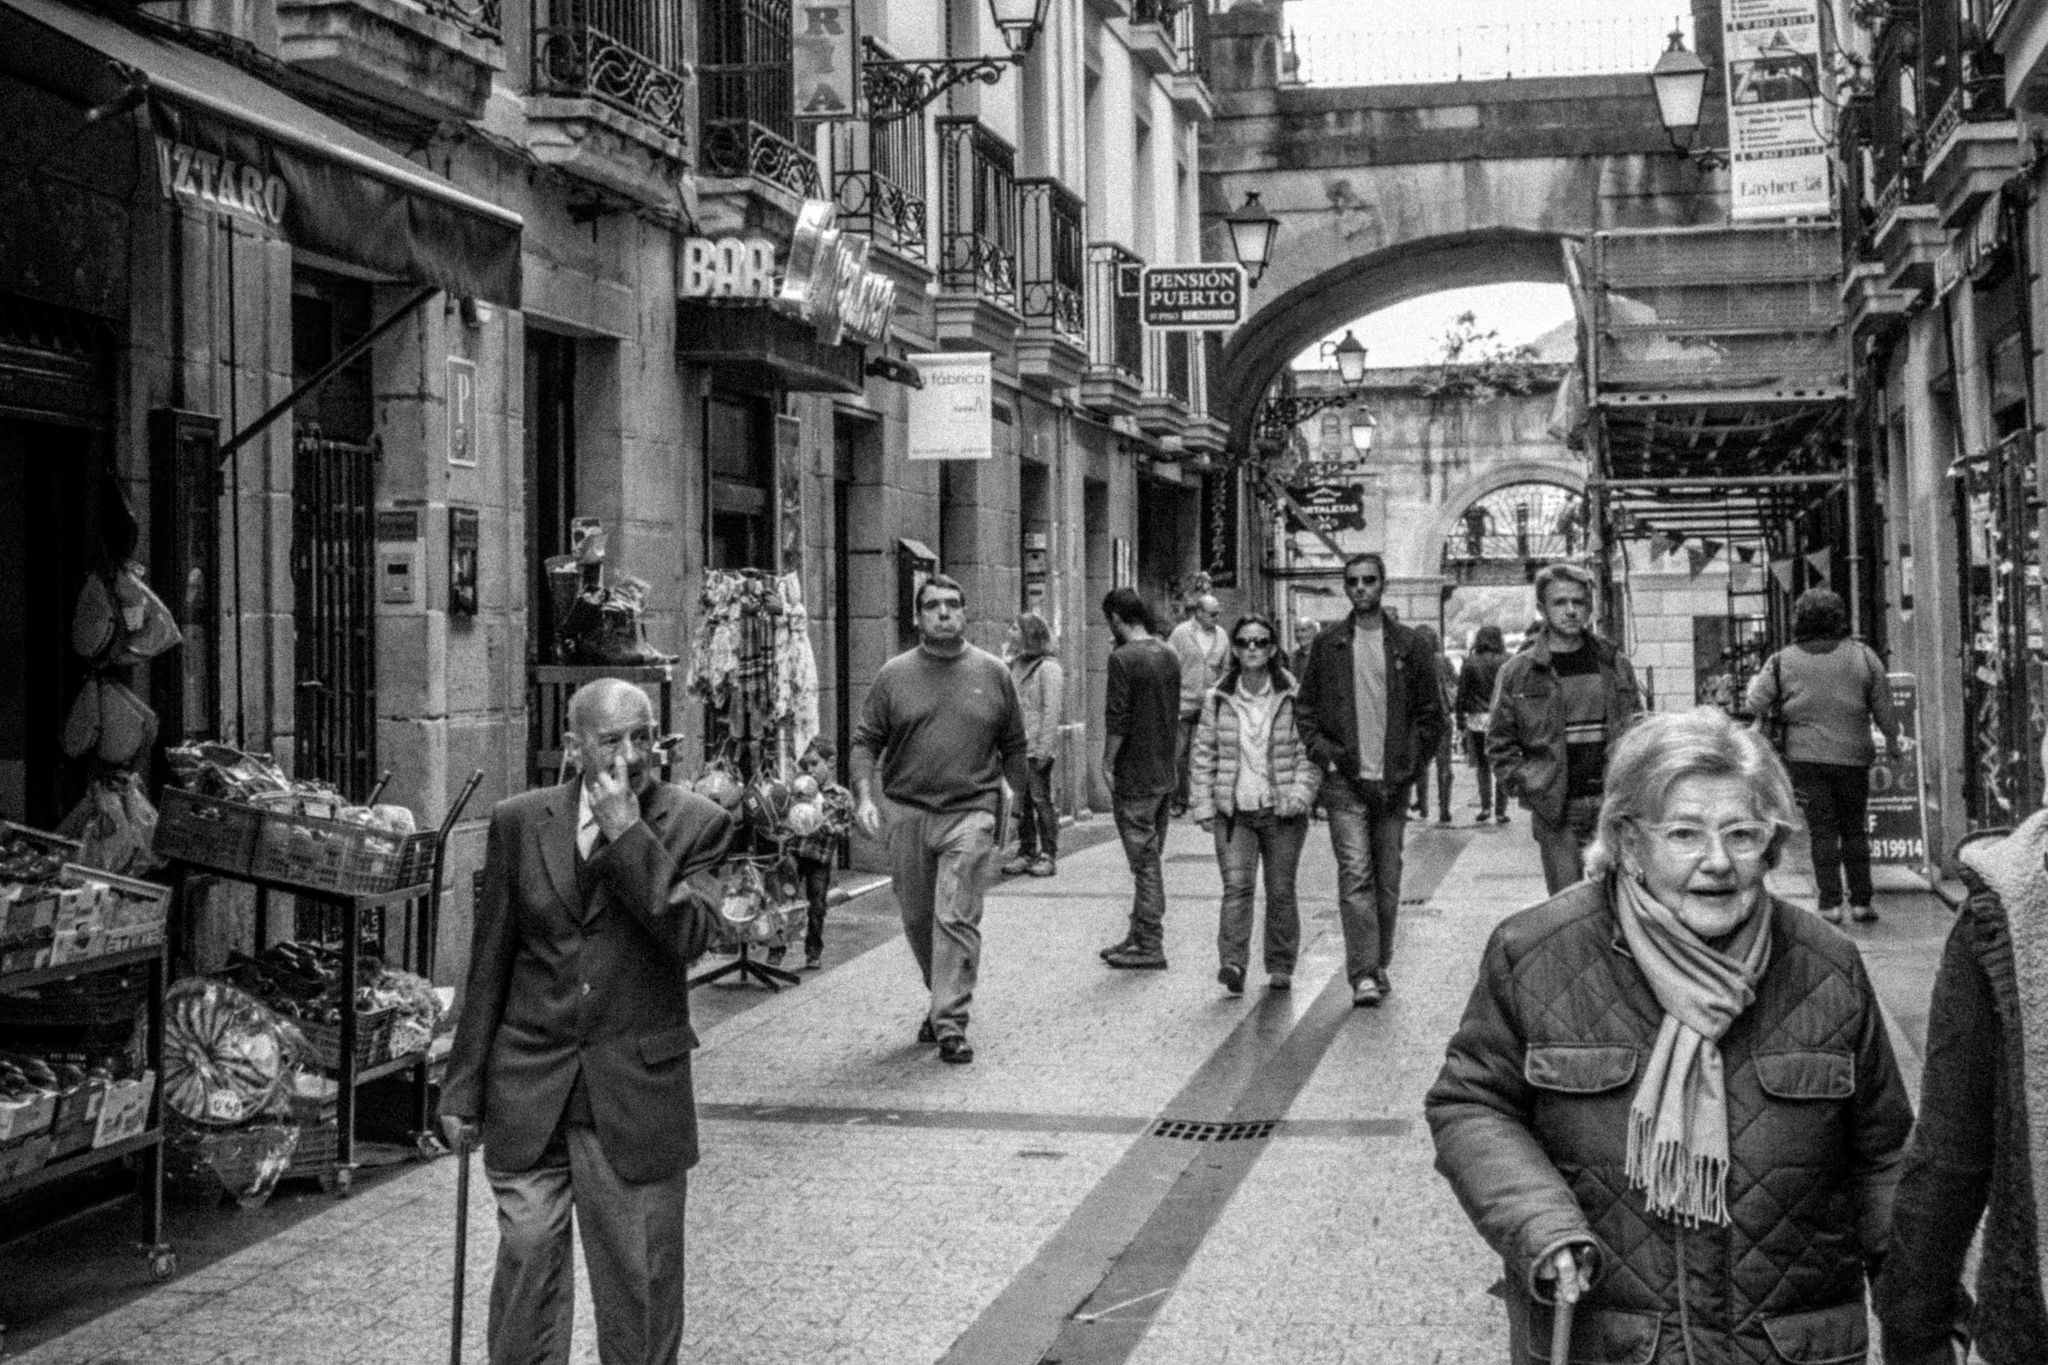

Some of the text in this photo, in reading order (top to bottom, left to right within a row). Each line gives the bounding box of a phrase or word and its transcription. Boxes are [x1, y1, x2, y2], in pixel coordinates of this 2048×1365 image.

[682, 236, 776, 298] BAR
[1150, 270, 1236, 289] PENSIÓN
[1150, 289, 1236, 306] PUERTO
[931, 371, 986, 386] fábrica
